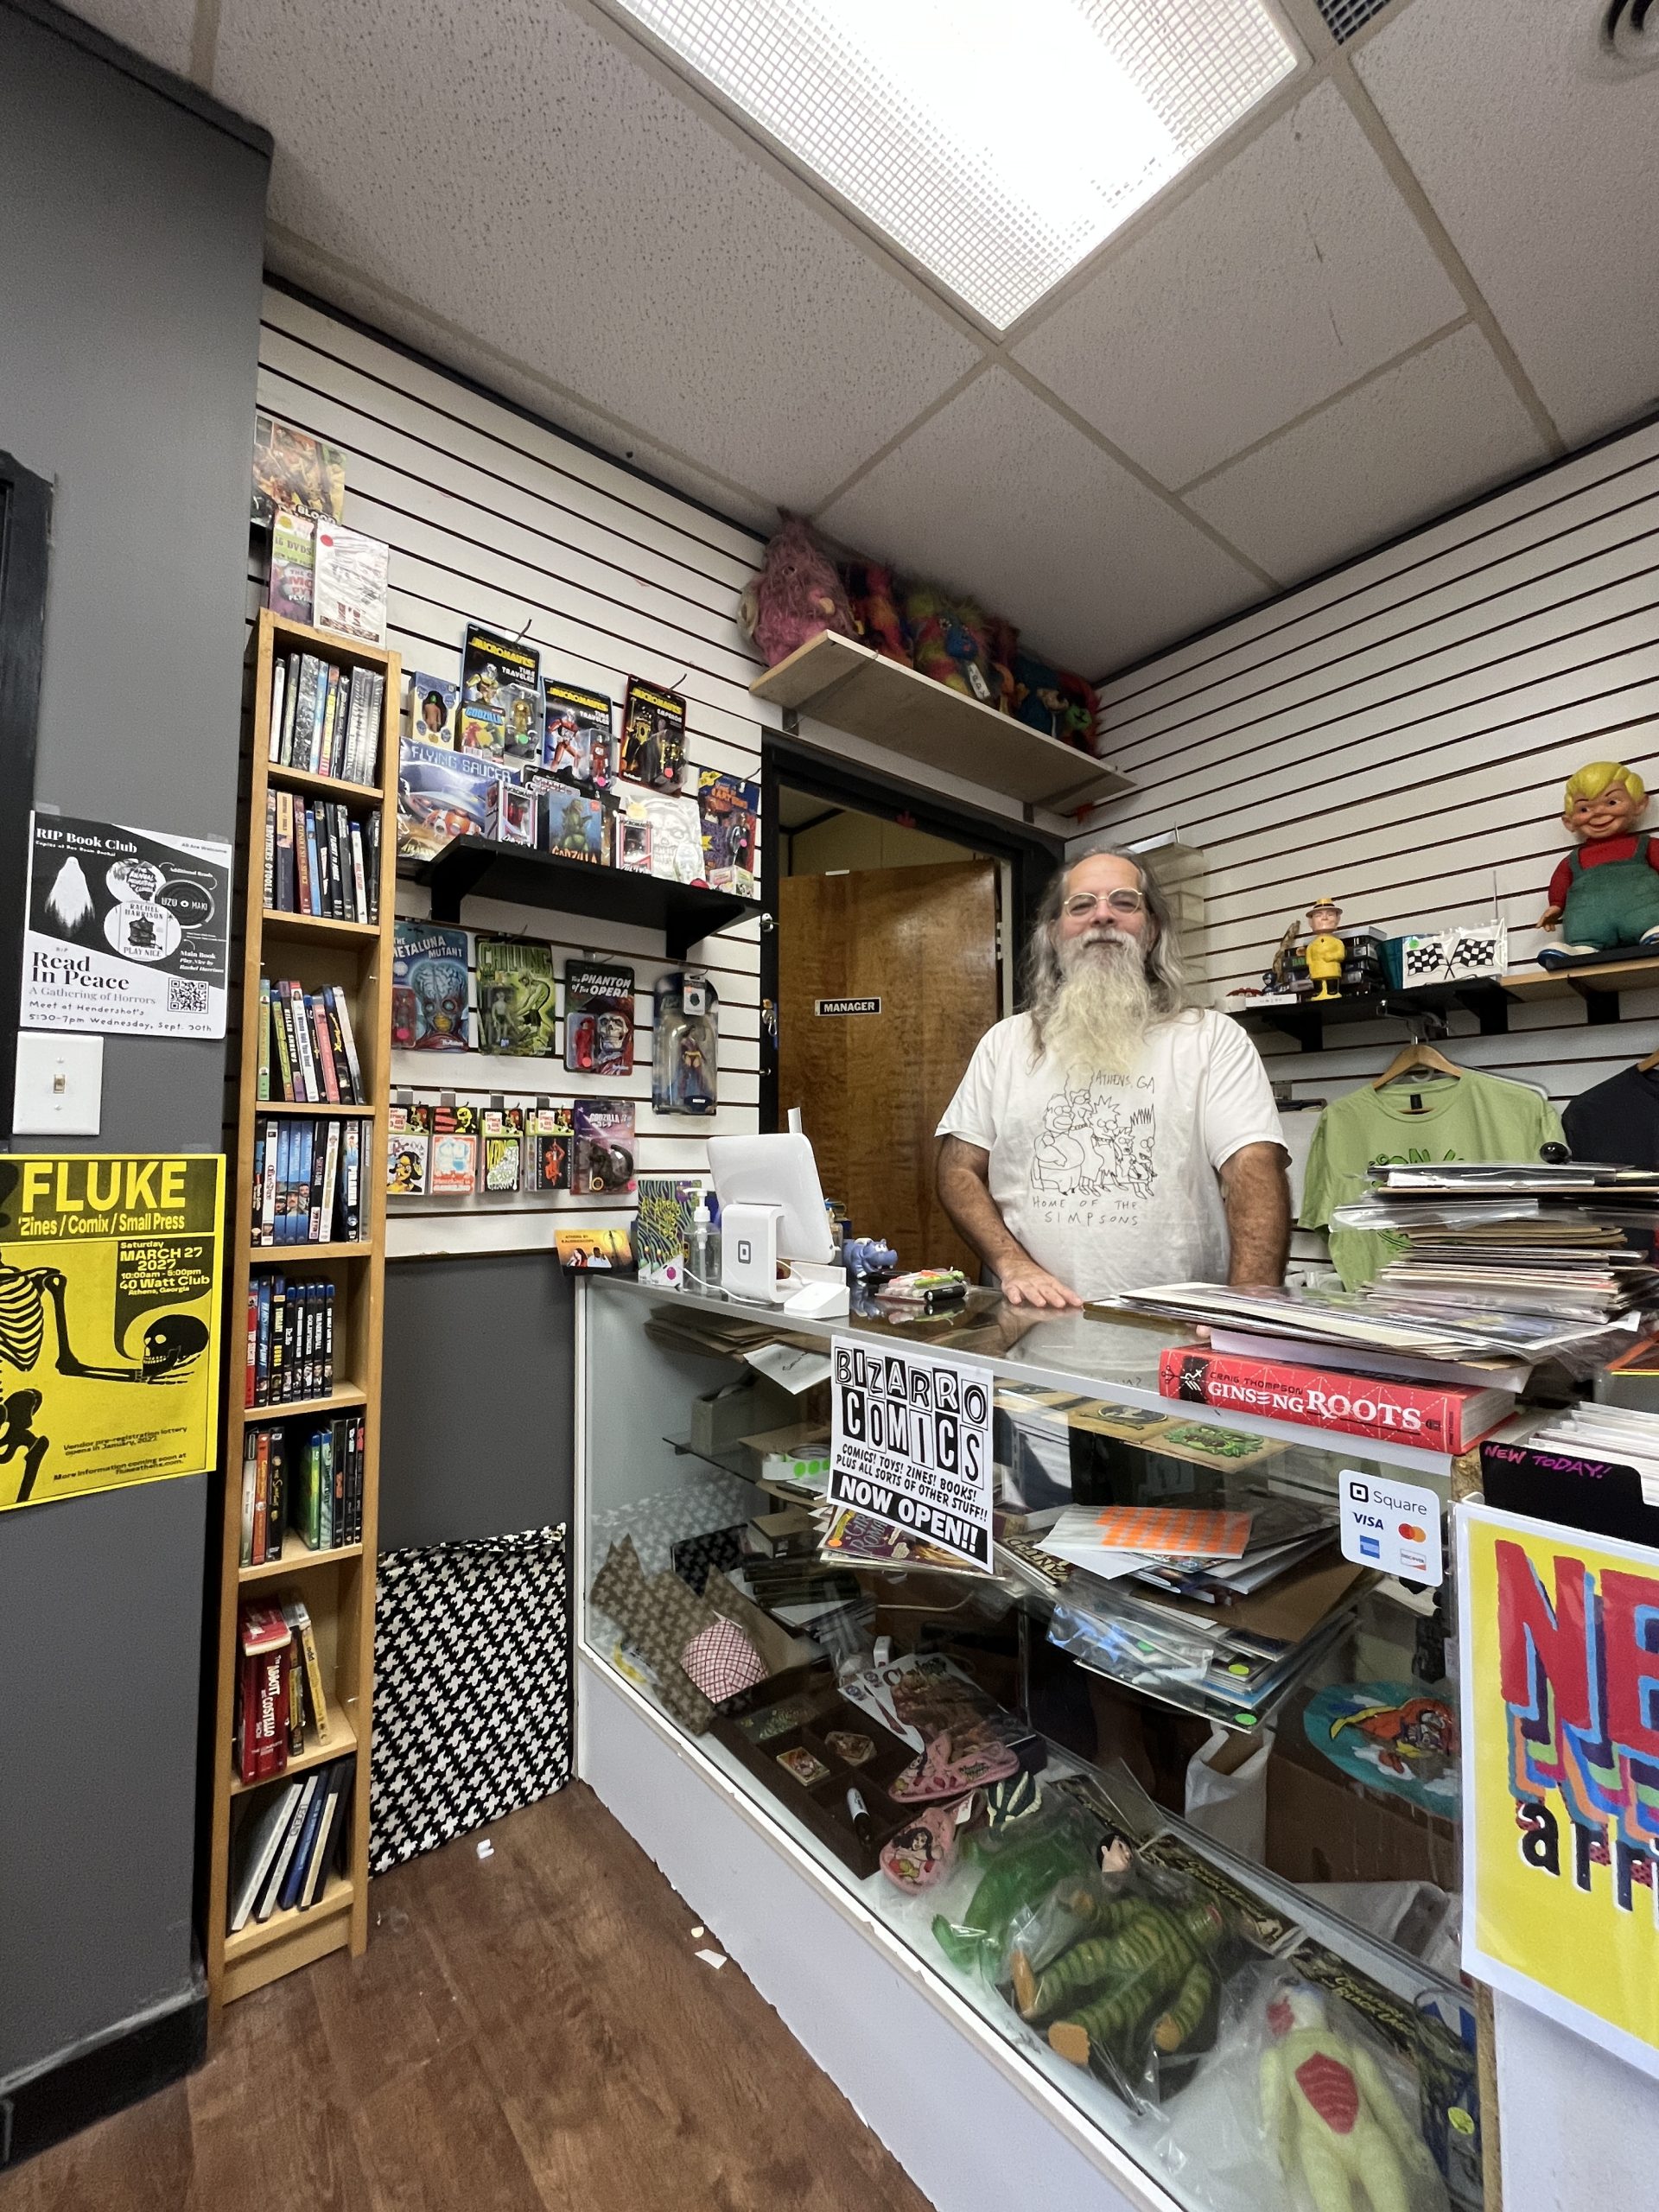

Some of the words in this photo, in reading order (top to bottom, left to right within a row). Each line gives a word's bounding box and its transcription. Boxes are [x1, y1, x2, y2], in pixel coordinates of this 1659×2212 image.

[547, 687, 609, 711] MICRONAUTS
[630, 686, 683, 715] MICRONAUTS
[465, 707, 503, 725] GODZILLA
[411, 746, 457, 769] FLYING
[462, 758, 511, 783] SAUCER
[36, 828, 63, 841] RIP
[67, 832, 102, 848] Book
[105, 839, 137, 854] Club
[264, 824, 274, 861] BROTHERS
[329, 835, 338, 855] FLIGHT
[162, 897, 178, 907] UZU
[192, 901, 208, 911] MAKI
[124, 908, 163, 919] HARRISON
[33, 951, 90, 972] Read
[124, 947, 144, 956] PLAY
[428, 947, 467, 959] MUTANT
[31, 967, 55, 983] In
[65, 969, 130, 990] Peace
[581, 974, 632, 988] PHANTOM
[29, 986, 38, 995] A
[41, 988, 98, 1001] Gathering
[99, 992, 111, 1001] of
[113, 993, 156, 1004] Horrors
[571, 983, 580, 993] of
[589, 984, 630, 998] OPERA
[29, 1001, 57, 1009] Meet
[77, 1004, 144, 1016] Hendershot's
[823, 1001, 875, 1013] MANAGER
[29, 1014, 85, 1024] 5:30-7pm
[90, 1017, 154, 1030] Wednesday,
[284, 1008, 293, 1033] KILLER
[288, 1034, 297, 1063] SHREWS
[1136, 1075, 1154, 1094] GA
[590, 1113, 620, 1123] GODZILLA
[22, 1160, 187, 1213] FLUKE
[1033, 1195, 1066, 1209] HOME
[1078, 1199, 1098, 1208] OF
[1114, 1199, 1138, 1210] THE
[68, 1214, 108, 1235] Comix
[118, 1212, 151, 1231] Small
[152, 1212, 185, 1230] Press
[1044, 1211, 1139, 1226] SIMPSONS
[120, 1248, 181, 1262] MARCH
[184, 1246, 203, 1258] 27
[137, 1259, 177, 1271] 2027
[119, 1280, 137, 1290] 40
[140, 1278, 175, 1288] Watt
[177, 1275, 210, 1286] Club
[315, 1313, 323, 1351] THUNDERBALL
[259, 1343, 268, 1368] POINT
[836, 1347, 988, 1428] BIZARRO
[1210, 1371, 1239, 1383] CRAIG
[1243, 1377, 1303, 1395] THOMPSON
[1207, 1382, 1304, 1414] GINSENG
[1306, 1389, 1421, 1430] ROOTS
[63, 1441, 94, 1451] Vendor
[95, 1432, 160, 1446] pre-registration
[842, 1387, 983, 1488] COMICS
[65, 1447, 92, 1456] opens
[1484, 1444, 1524, 1465] NEW
[54, 1471, 77, 1480] More
[77, 1464, 127, 1476] information
[127, 1458, 157, 1468] coming
[842, 1443, 876, 1465] COMICS!
[880, 1456, 905, 1473] TOYS!
[906, 1464, 936, 1486] ZINES!
[940, 1478, 977, 1502] BOOKS!
[836, 1453, 856, 1471] PLUS
[858, 1462, 874, 1478] ALL
[875, 1466, 901, 1487] SORTS
[904, 1477, 916, 1491] OF
[918, 1484, 949, 1506] OTHER
[951, 1496, 988, 1522] STUFF!!
[1373, 1491, 1427, 1516] Square
[839, 1475, 894, 1514] NOW
[898, 1496, 980, 1554] OPEN!!
[1351, 1511, 1384, 1530] VISA
[306, 1647, 315, 1662] odd
[1495, 1540, 1659, 1784] NE
[266, 1664, 281, 1696] ABBOTT
[262, 1697, 276, 1738] COSTELLO
